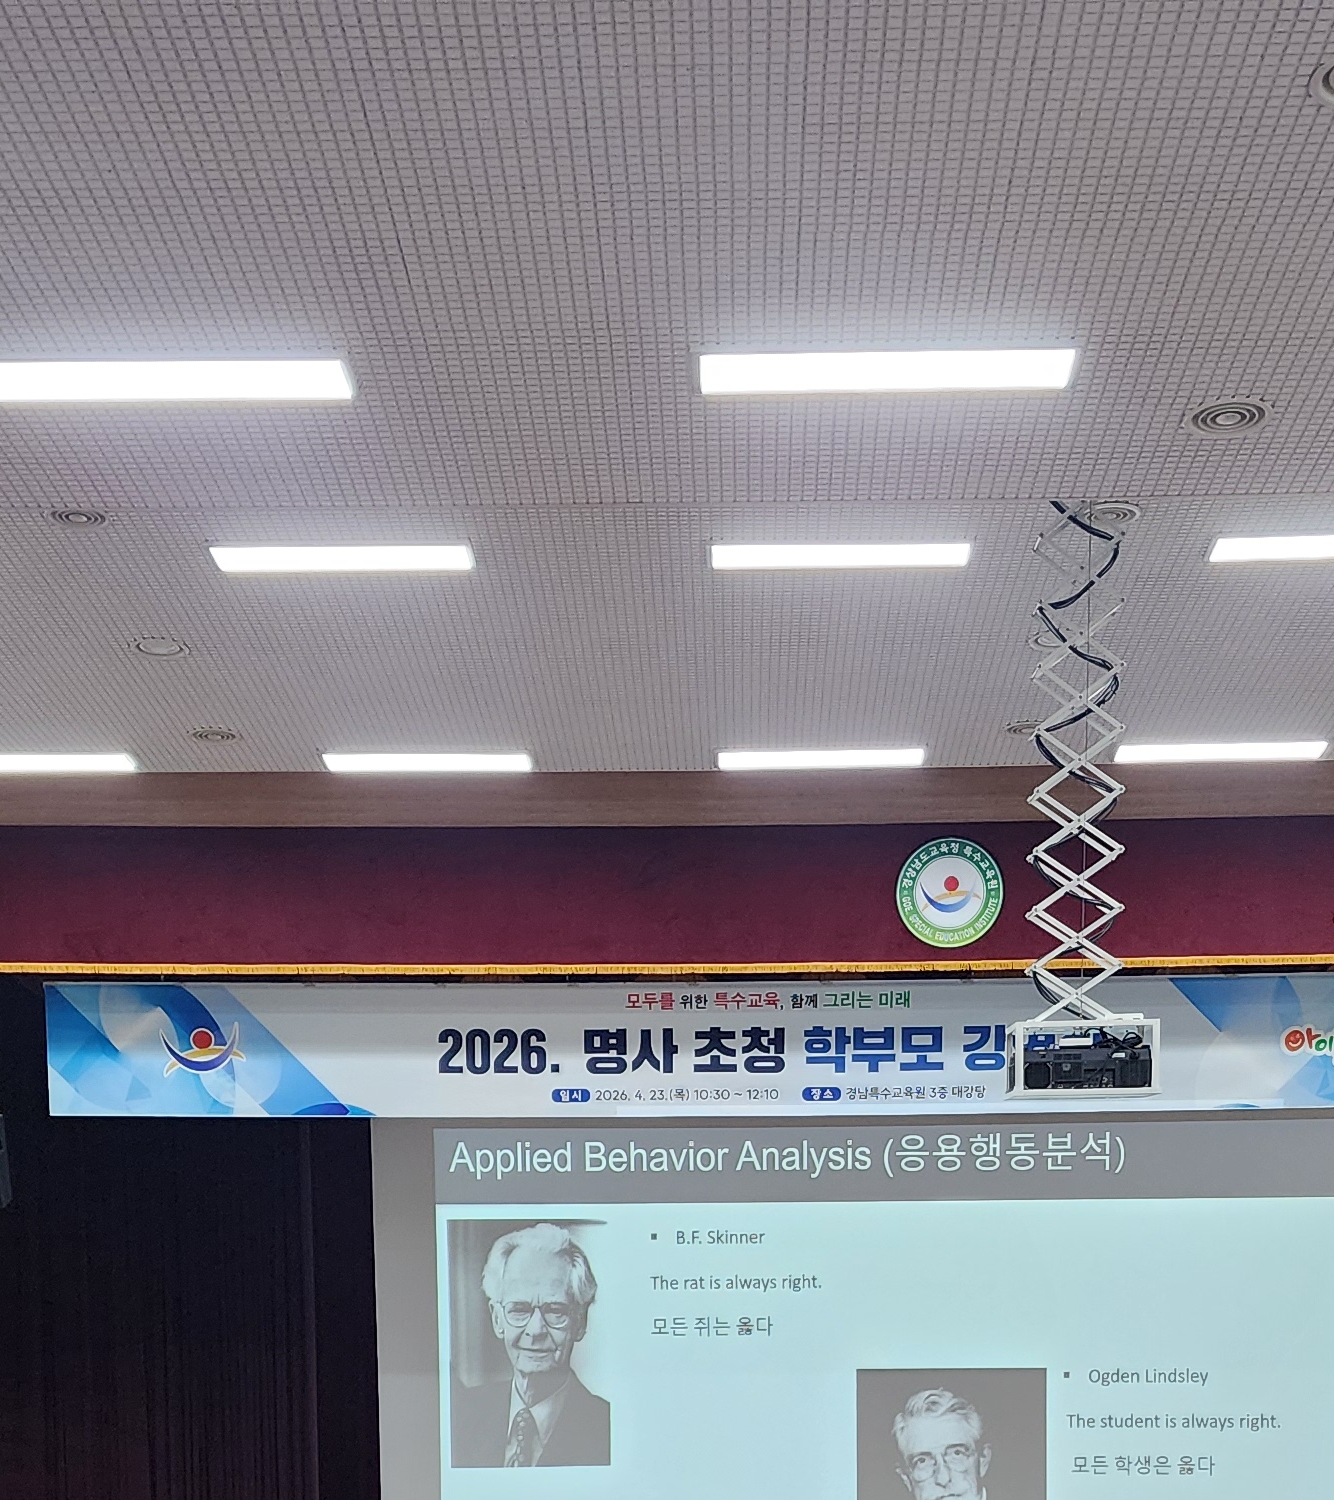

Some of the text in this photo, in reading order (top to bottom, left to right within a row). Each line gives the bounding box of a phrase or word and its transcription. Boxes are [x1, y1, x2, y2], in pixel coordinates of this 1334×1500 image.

[934, 926, 976, 942] EDUCATION
[975, 897, 999, 931] INSTITUTE
[625, 990, 912, 1012] 모두를 위한 특수교육, 함께 그리는 미래
[437, 1027, 560, 1075] 2026.
[583, 1027, 679, 1075] 명사
[693, 1025, 786, 1074] 초청
[803, 1024, 944, 1074] 학부모
[595, 1089, 631, 1102] 2026.
[634, 1089, 646, 1102] 4.
[694, 1088, 731, 1101] 10:30
[746, 1088, 779, 1101] 12:10
[810, 1087, 834, 1101] 장소
[448, 1131, 1127, 1180] Applied Behavior Analysis (응용행동분석)
[676, 1229, 766, 1245] B.F. Skinner
[650, 1273, 823, 1293] The rat is always right.
[650, 1315, 774, 1337] 모든 쥐는 옳다
[1088, 1367, 1209, 1387] Ogden Lindsley
[1065, 1413, 1282, 1432] The student is always right.
[1071, 1454, 1216, 1477] 모든 학생은 옳다
